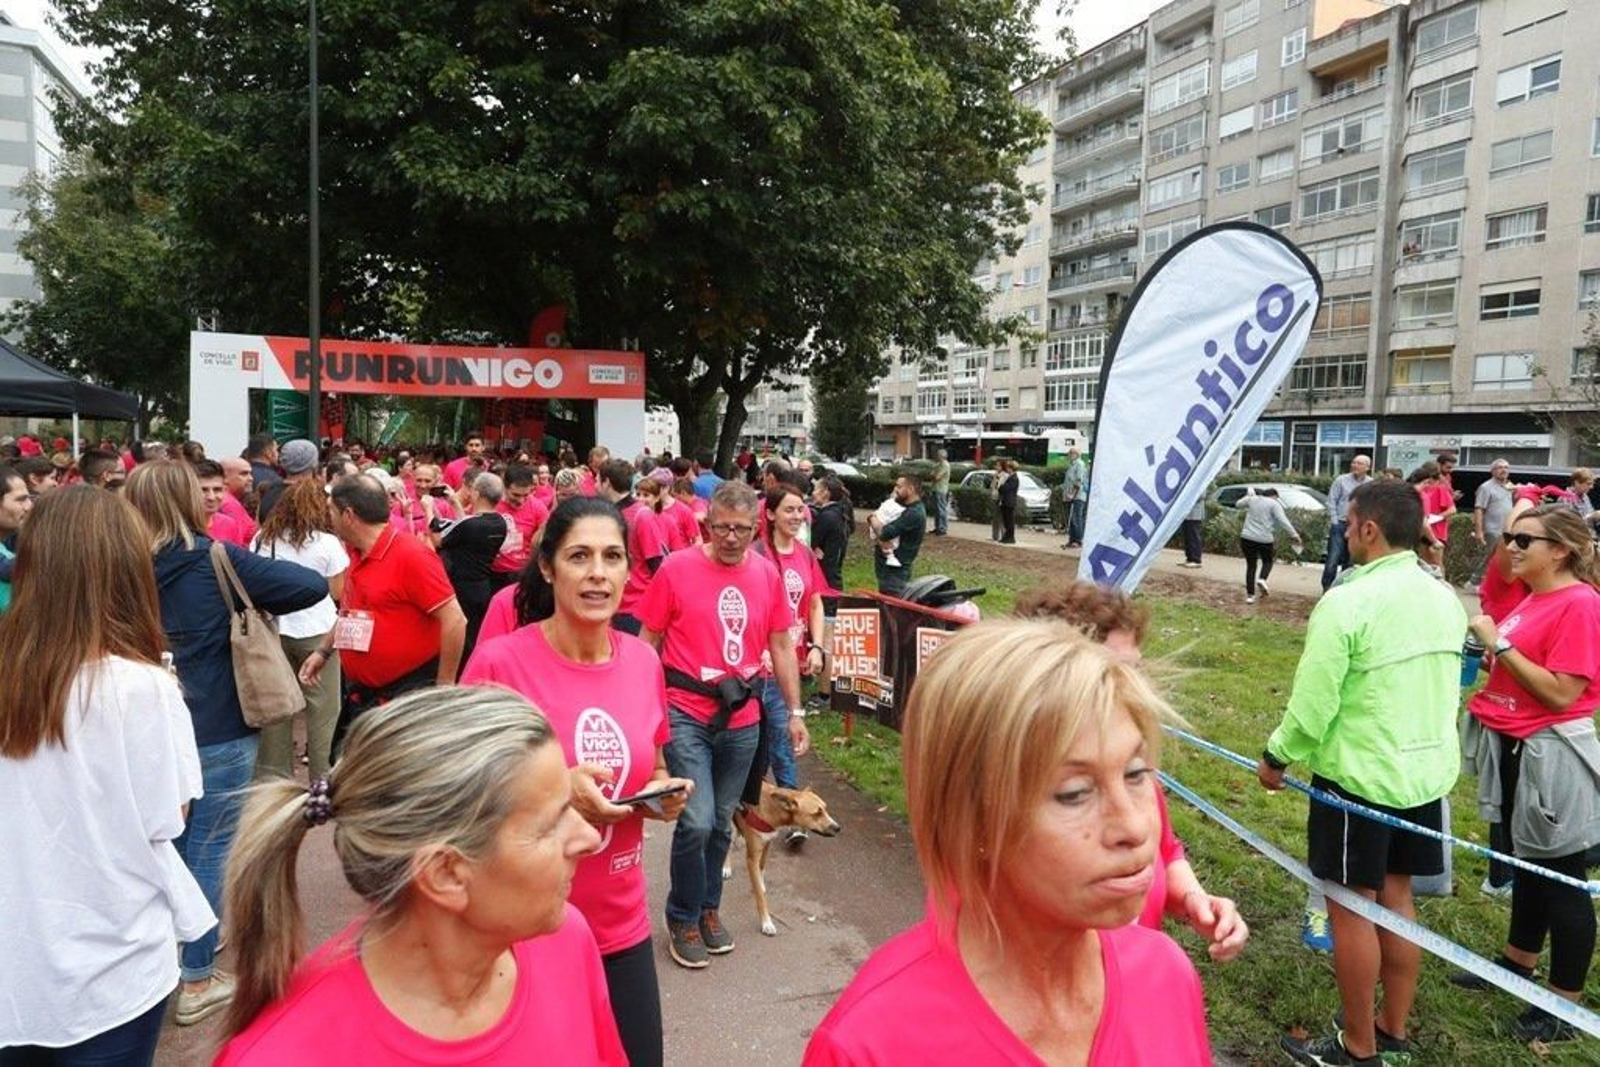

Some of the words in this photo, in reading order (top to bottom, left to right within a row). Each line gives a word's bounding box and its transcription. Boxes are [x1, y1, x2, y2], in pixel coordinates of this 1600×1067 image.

[199, 351, 237, 360] CONCELLO
[1088, 283, 1295, 588] Atlántico
[834, 614, 875, 635] SAVE
[834, 636, 866, 655] THE
[583, 738, 620, 751] VIGO
